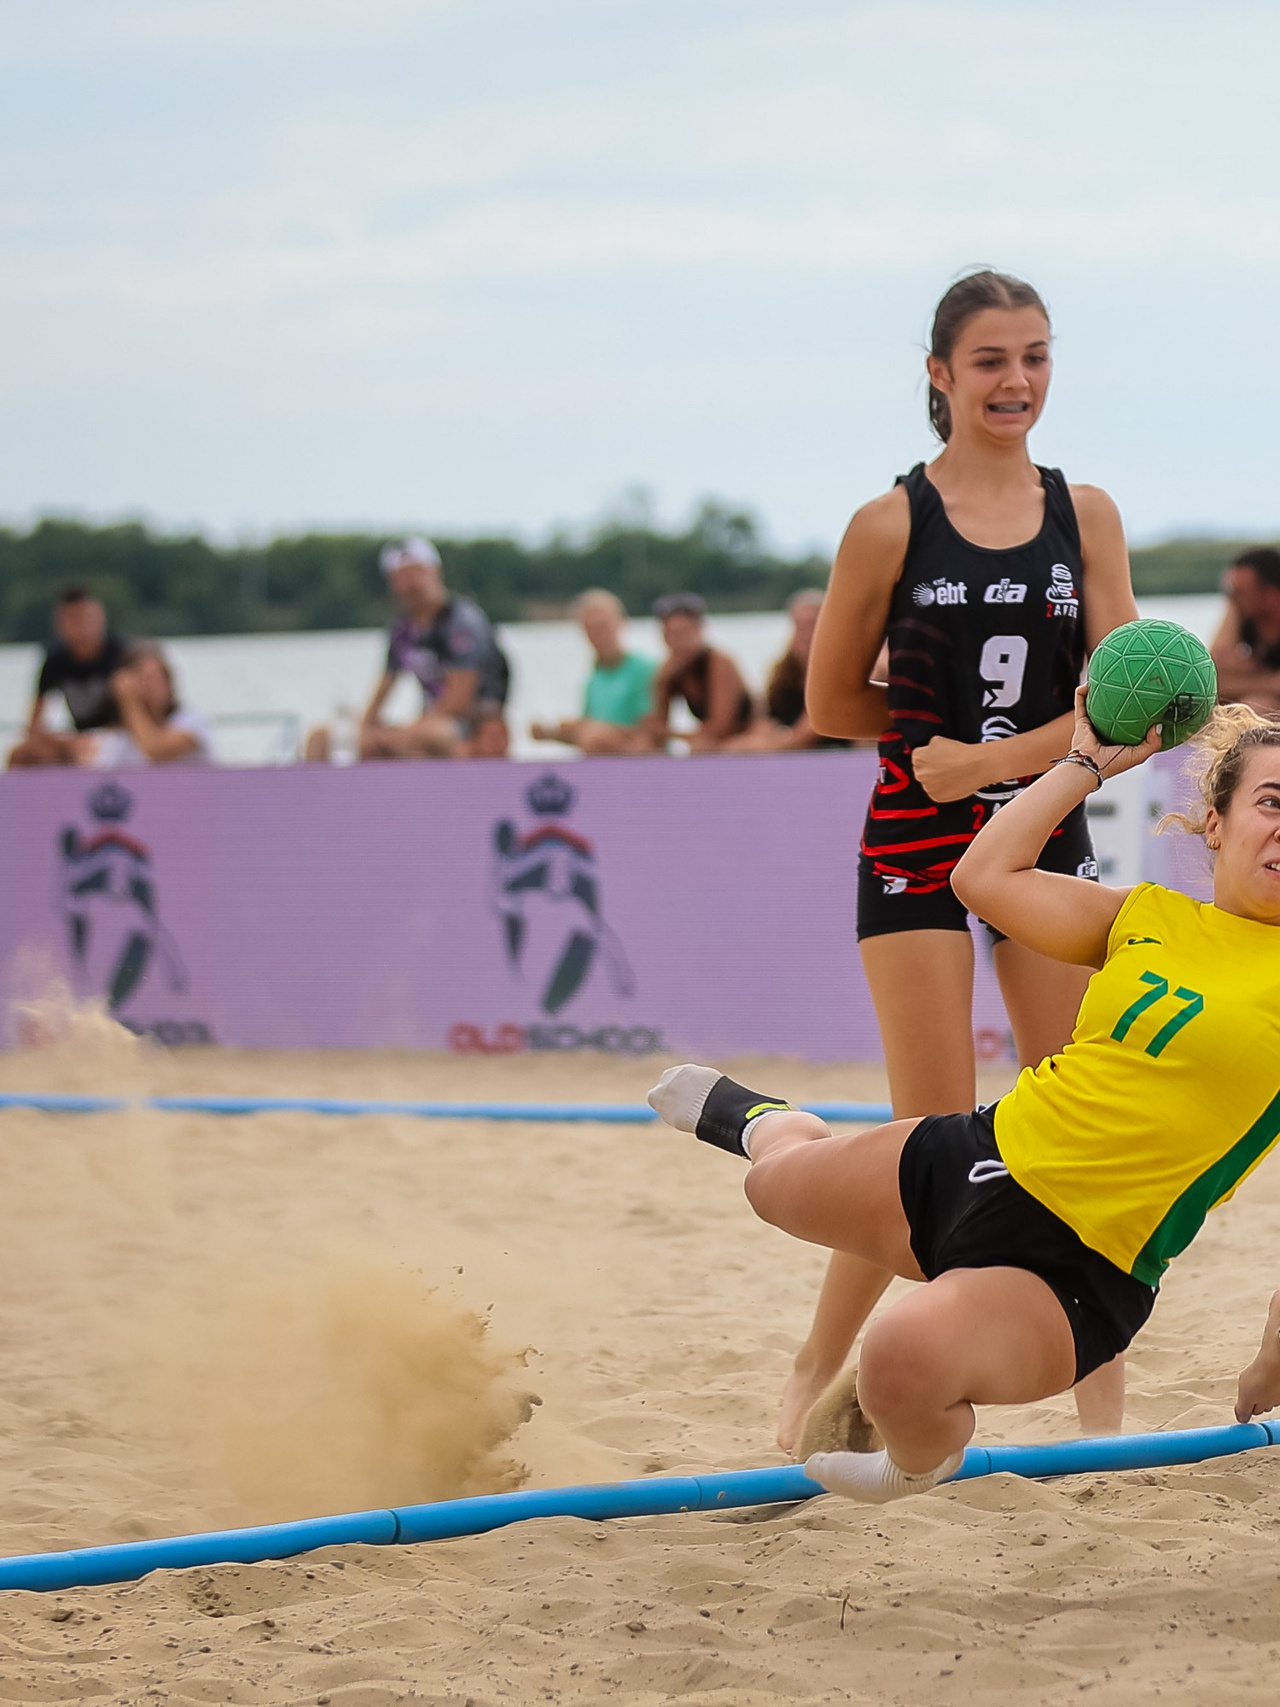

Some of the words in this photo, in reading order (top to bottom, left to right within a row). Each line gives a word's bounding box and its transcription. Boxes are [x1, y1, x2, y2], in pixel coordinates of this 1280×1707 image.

[936, 581, 968, 605] ebt
[979, 635, 1029, 708] 9
[1110, 970, 1204, 1058] 77
